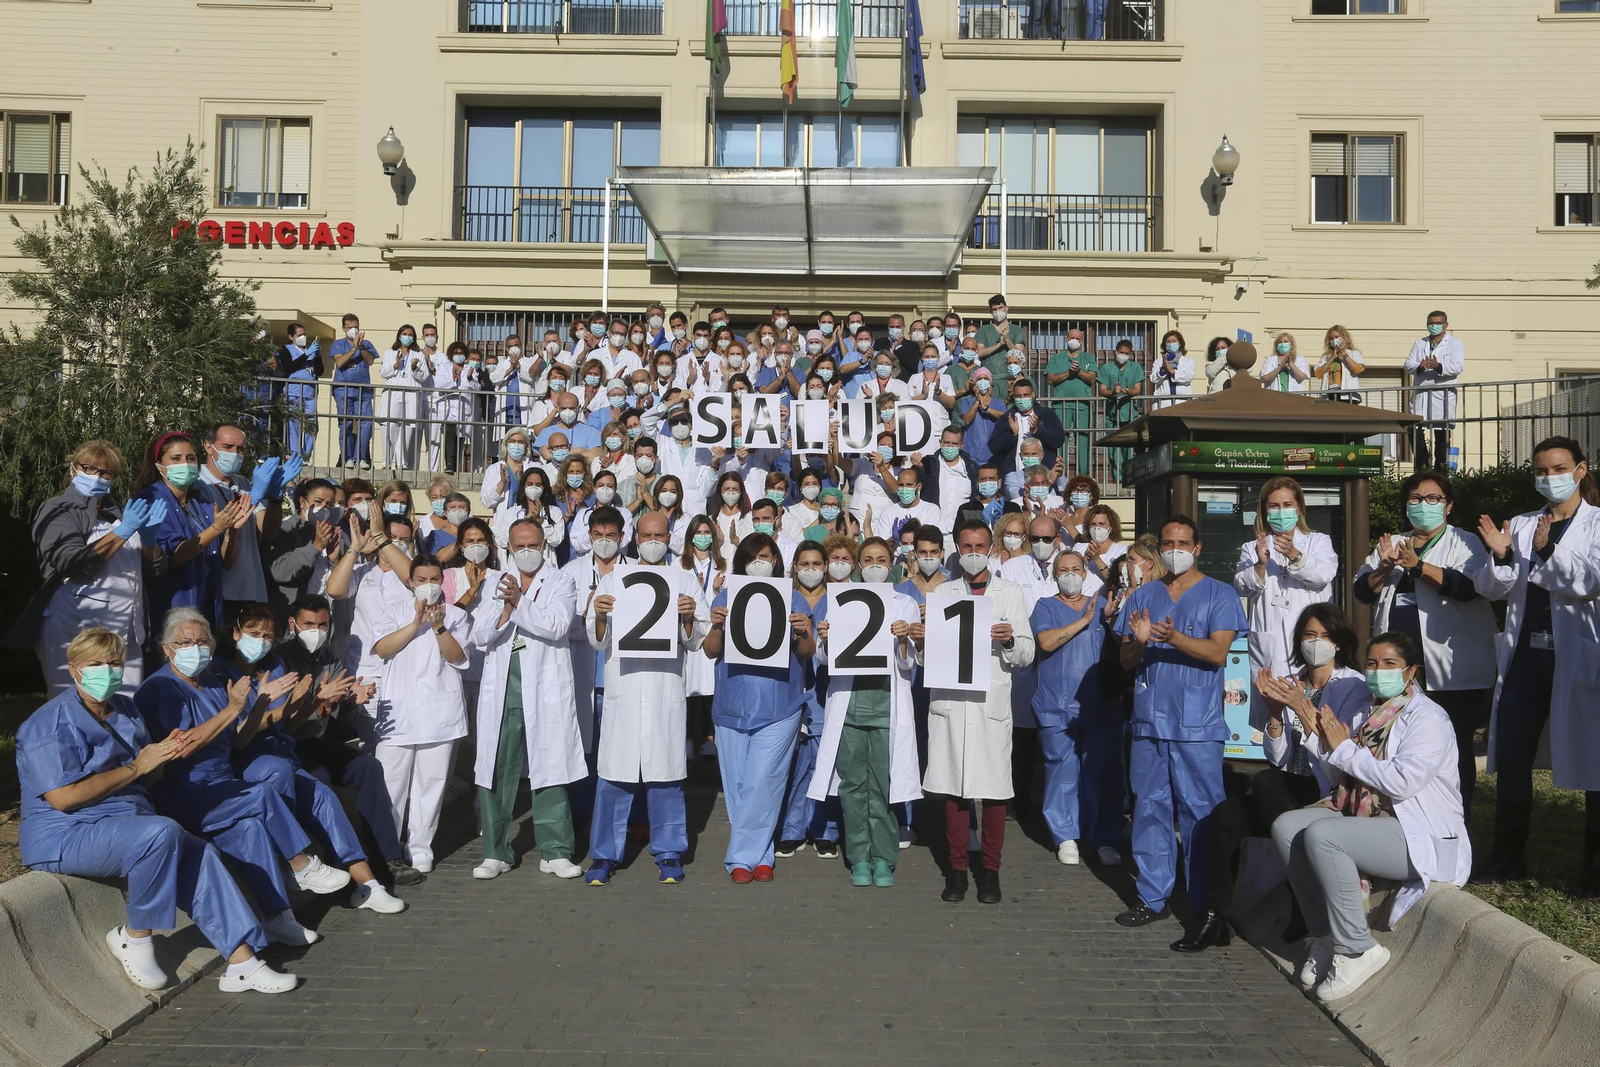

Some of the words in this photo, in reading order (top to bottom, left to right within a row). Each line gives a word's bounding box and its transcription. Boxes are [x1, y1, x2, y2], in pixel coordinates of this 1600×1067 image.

[1214, 448, 1243, 459] Cupón
[1245, 448, 1270, 458] Extra
[1323, 449, 1342, 457] Enero
[1215, 459, 1226, 468] de
